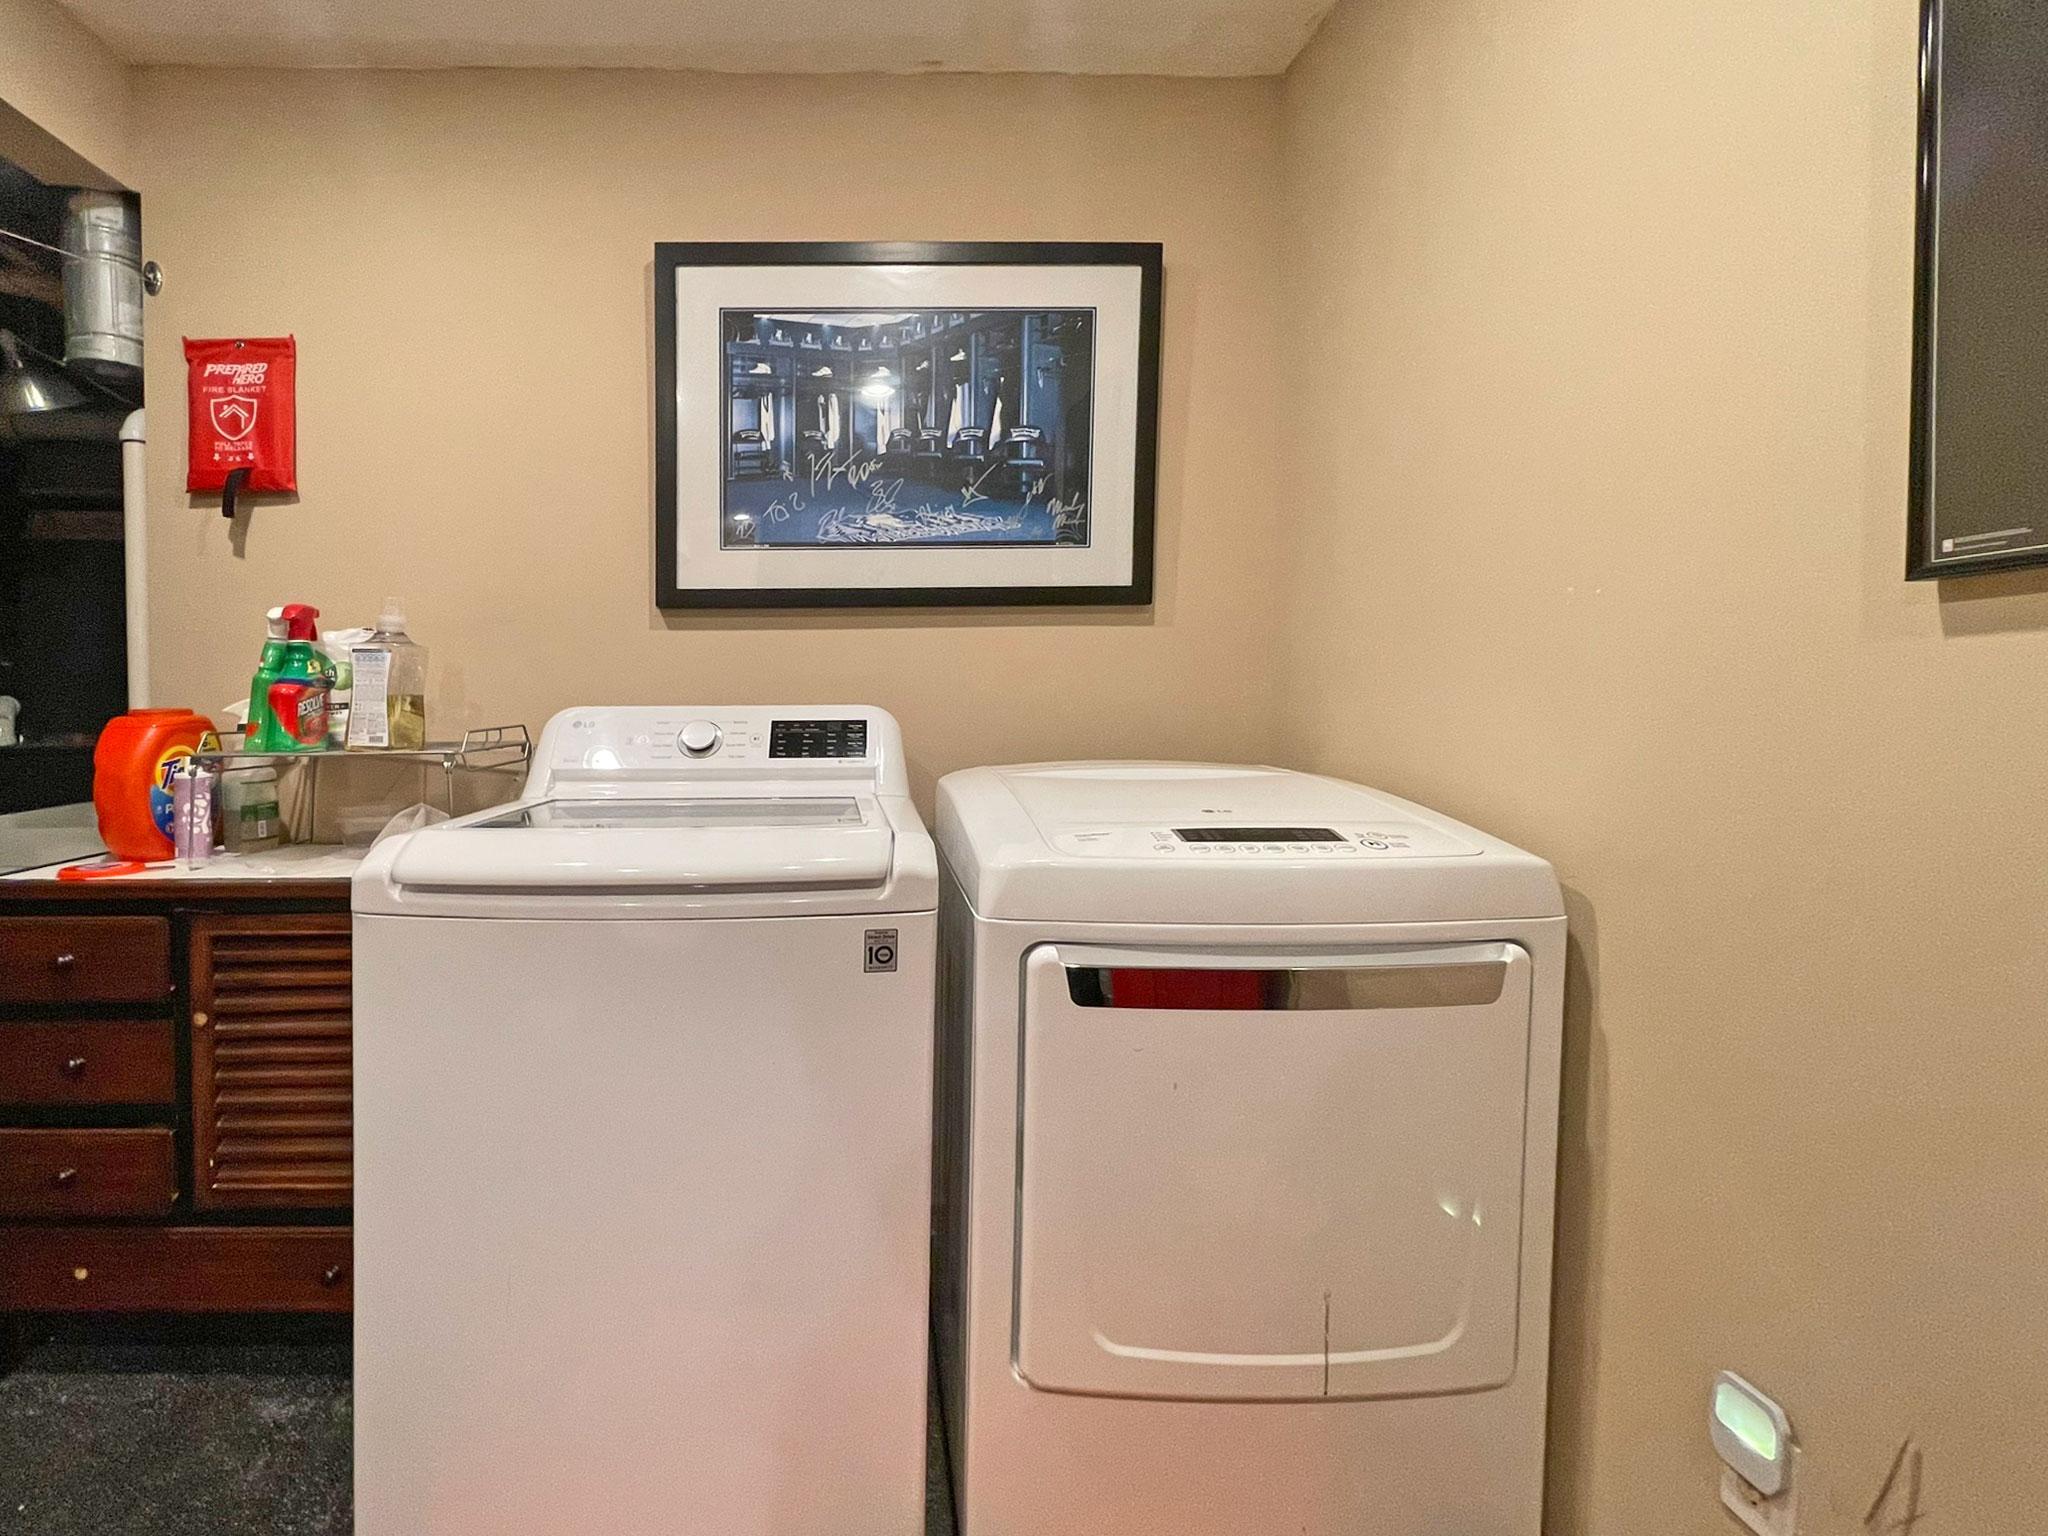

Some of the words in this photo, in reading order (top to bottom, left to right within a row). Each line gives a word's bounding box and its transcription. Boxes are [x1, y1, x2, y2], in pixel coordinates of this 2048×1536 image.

[203, 363, 268, 377] PREPARED
[232, 373, 265, 385] HERO
[203, 386, 225, 394] FIRE
[227, 385, 267, 394] BLANKET
